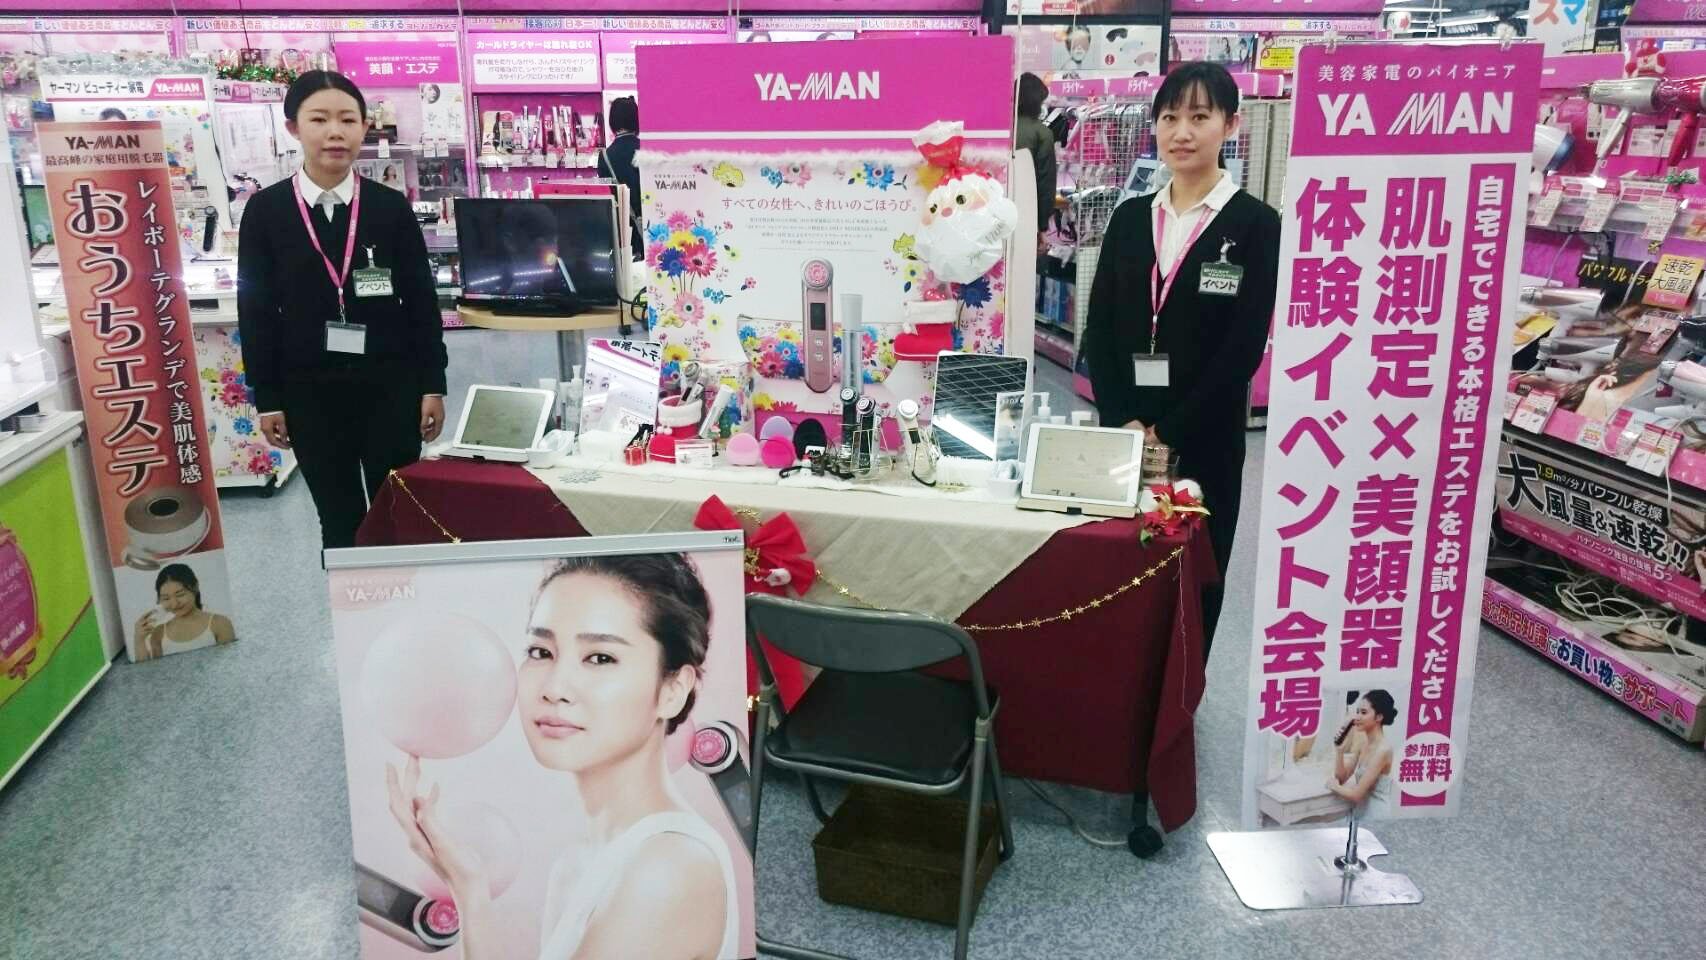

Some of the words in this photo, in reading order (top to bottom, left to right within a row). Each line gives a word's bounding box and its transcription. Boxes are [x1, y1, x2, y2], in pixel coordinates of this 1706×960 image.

[369, 62, 440, 76] 美顔・エステ
[1318, 63, 1517, 82] 美容家電のパイオニア
[49, 81, 81, 94] ヤーマン
[754, 71, 880, 101] YA-MAN
[64, 134, 141, 150] YA-MAN
[654, 180, 697, 190] YA-MAN
[721, 197, 918, 212] すべての女性へ、きれいのごほうび。
[1202, 279, 1236, 291] イベント
[66, 180, 168, 496] おうちエステ
[138, 181, 203, 485] レイボーテグランデで美肌体感
[1339, 176, 1453, 672] 肌測定×美顔器
[1257, 176, 1368, 738] 体験イベント会場
[1417, 175, 1504, 727] 自宅でできる本格エステをお試しください
[345, 585, 416, 601] YA-MAN
[1404, 743, 1450, 758] 参加費
[1399, 758, 1452, 783] 無料
